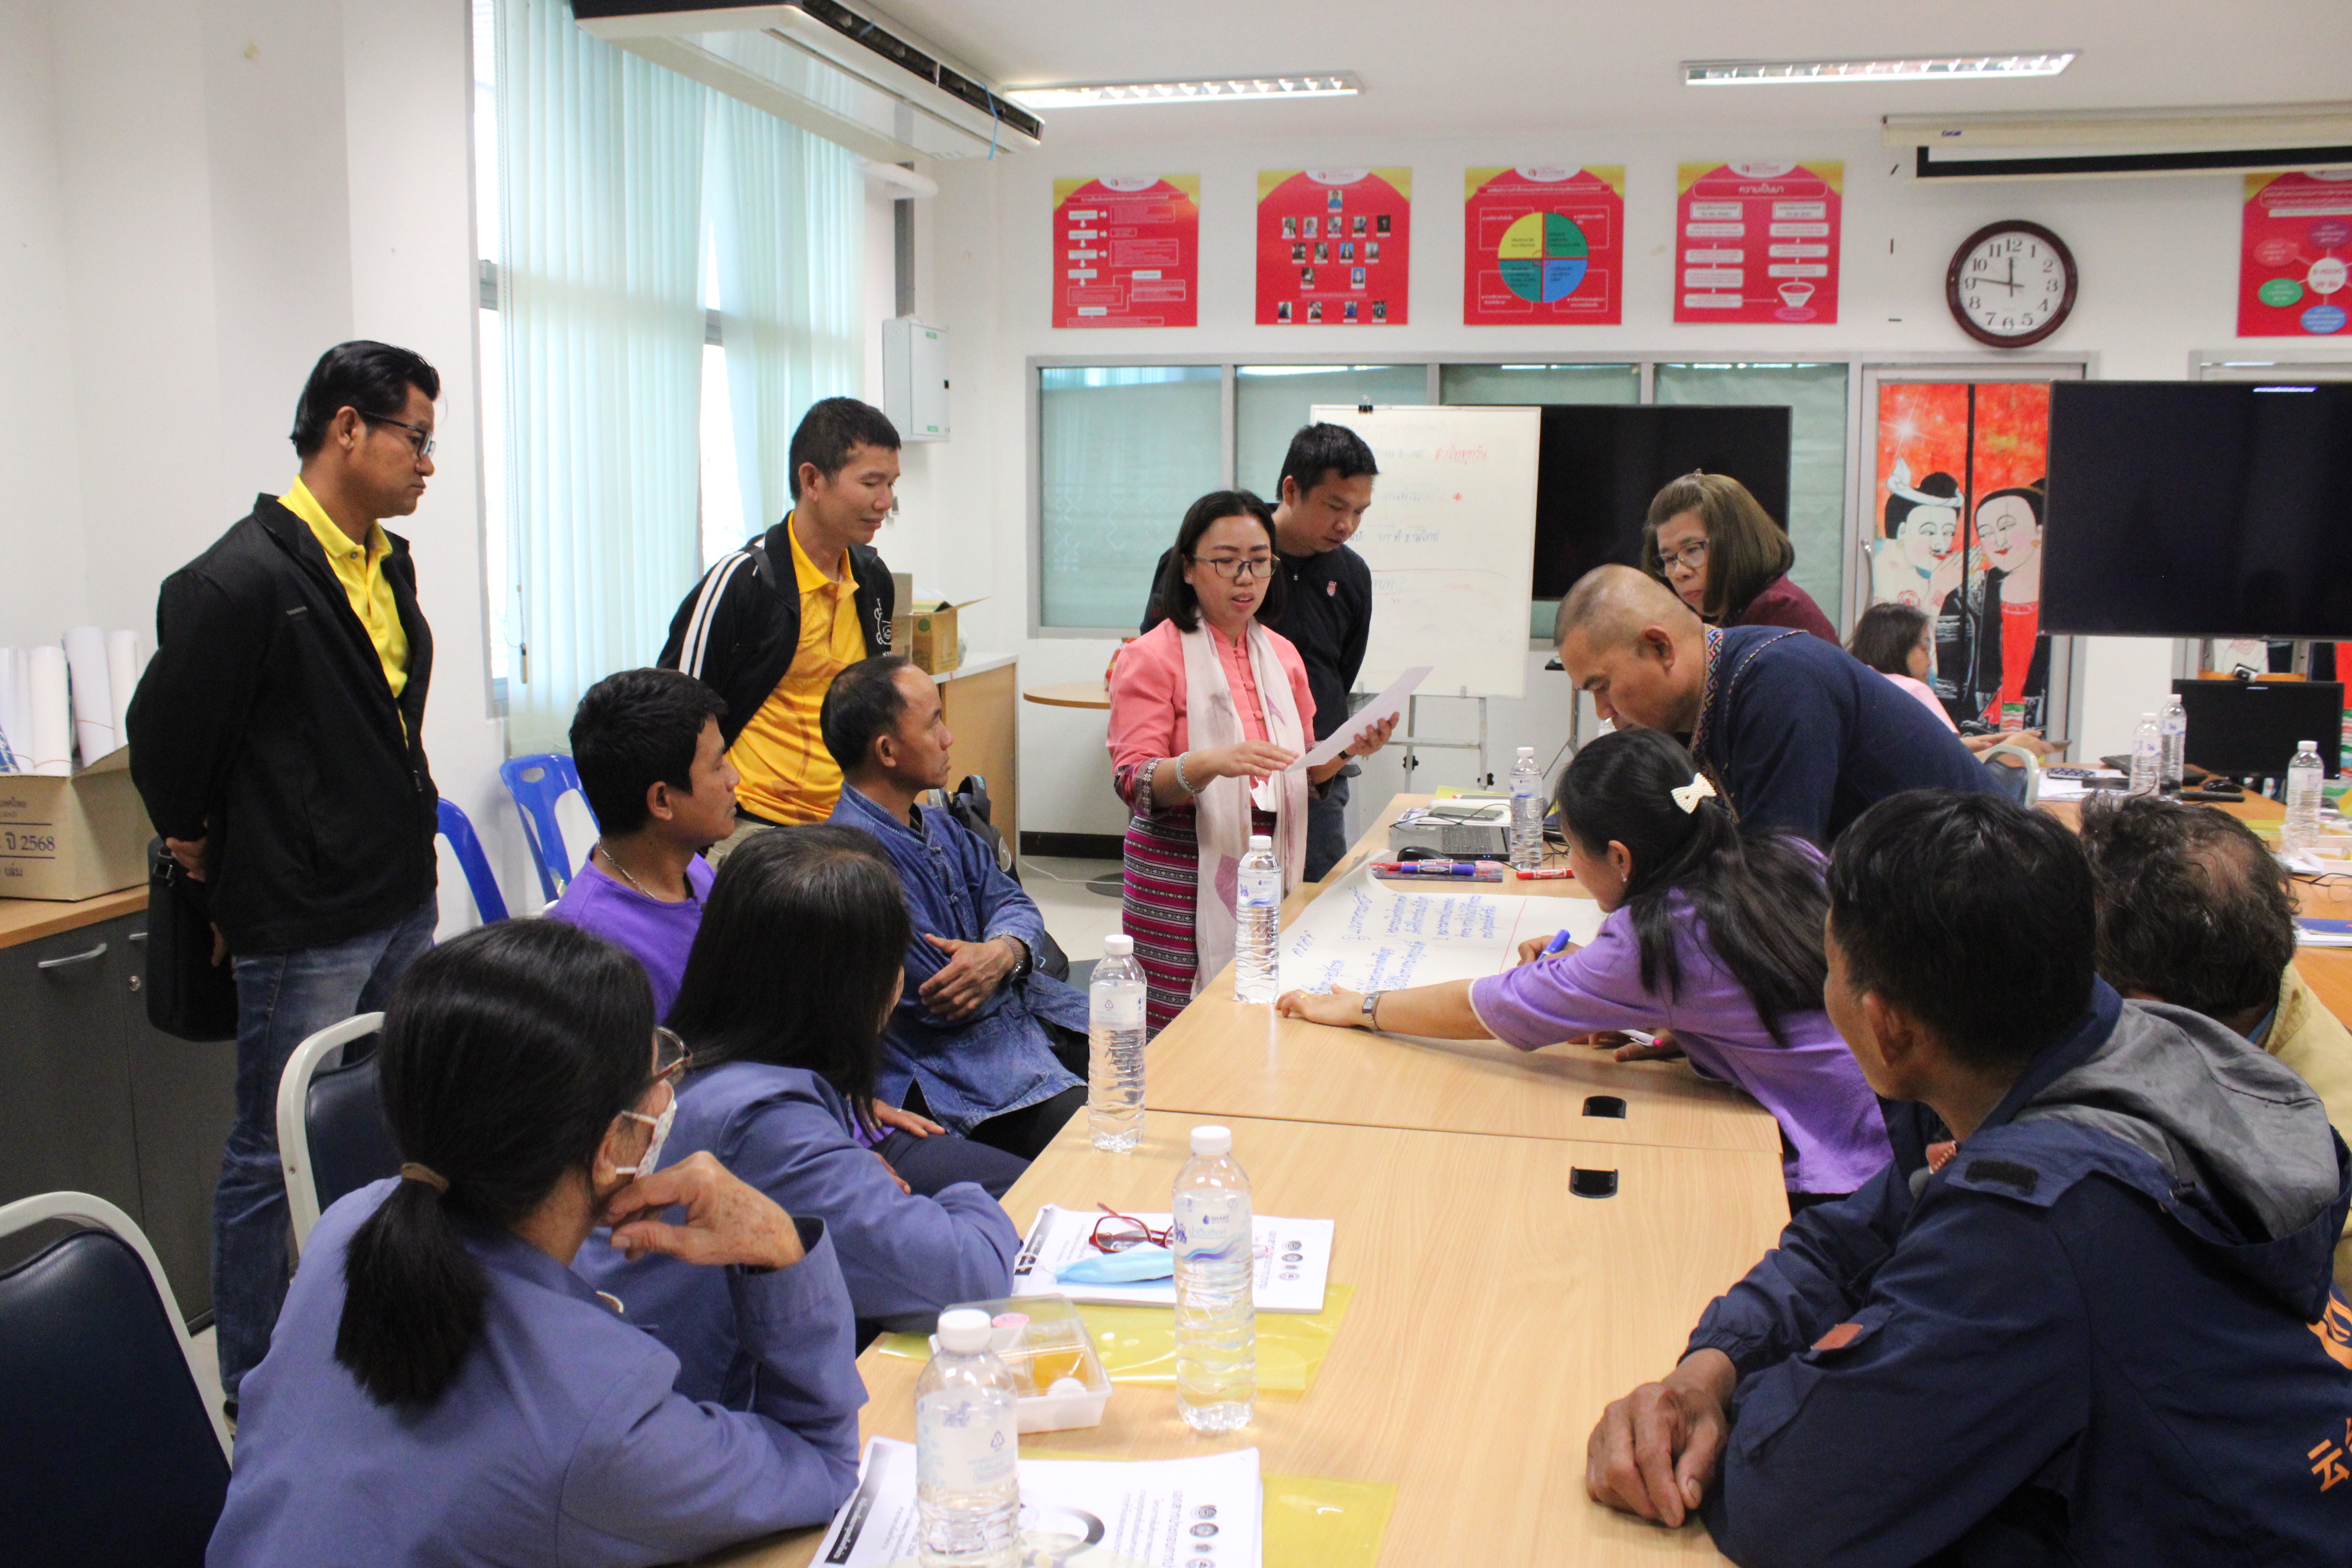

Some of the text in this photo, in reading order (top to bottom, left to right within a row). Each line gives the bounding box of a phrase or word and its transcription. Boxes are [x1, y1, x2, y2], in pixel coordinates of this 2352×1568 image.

[1739, 182, 1785, 194] ความเป็นมา
[1989, 243, 2001, 259] 11
[2006, 238, 2023, 252] 12
[2031, 244, 2037, 259] 1
[1972, 258, 1988, 272] 10
[2043, 259, 2054, 273] 2
[1965, 276, 1977, 290] 9
[2046, 278, 2059, 292] 3
[1969, 296, 1981, 310] 8
[2037, 298, 2049, 312] 4
[1985, 312, 1997, 326] 7
[2002, 316, 2014, 331] 6
[2021, 312, 2034, 326] 5
[5, 831, 55, 851] ปี 2568
